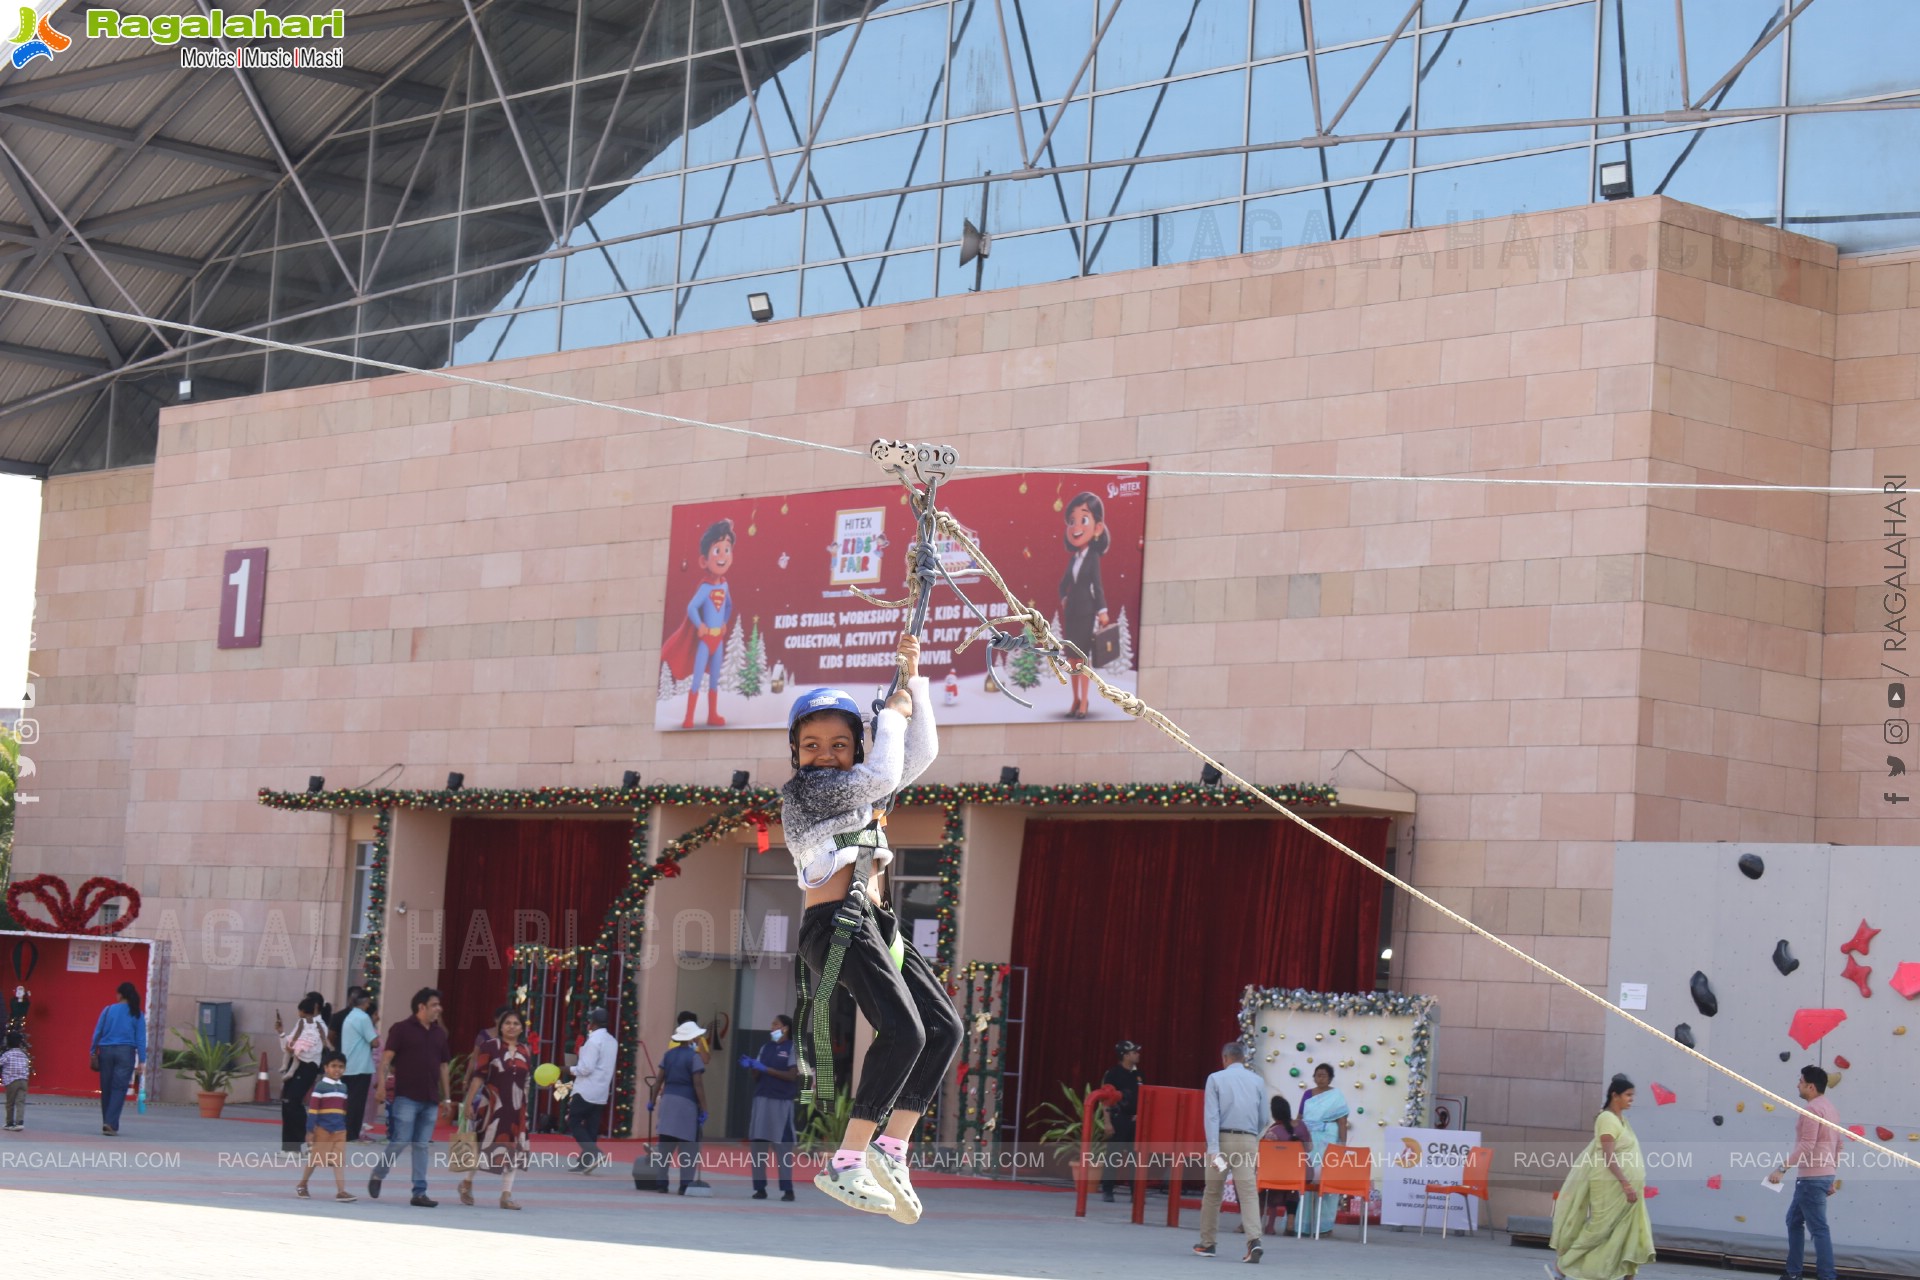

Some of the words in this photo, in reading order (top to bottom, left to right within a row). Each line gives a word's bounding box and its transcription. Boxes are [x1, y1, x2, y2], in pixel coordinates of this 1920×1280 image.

[845, 517, 872, 530] HITEX
[840, 555, 869, 573] FAIR
[228, 558, 251, 638] 1
[774, 614, 798, 629] KIDS
[800, 612, 836, 628] STALLS,
[839, 608, 900, 626] WORKSHOP
[934, 605, 961, 621] KIDS
[989, 602, 1009, 618] BIB
[784, 633, 842, 649] COLLECTION,
[844, 630, 898, 647] ACTIVITY
[932, 626, 962, 643] PLAY
[819, 654, 844, 669] KIDS
[845, 652, 898, 668] BUSINESS
[1428, 1142, 1470, 1156] CRAG
